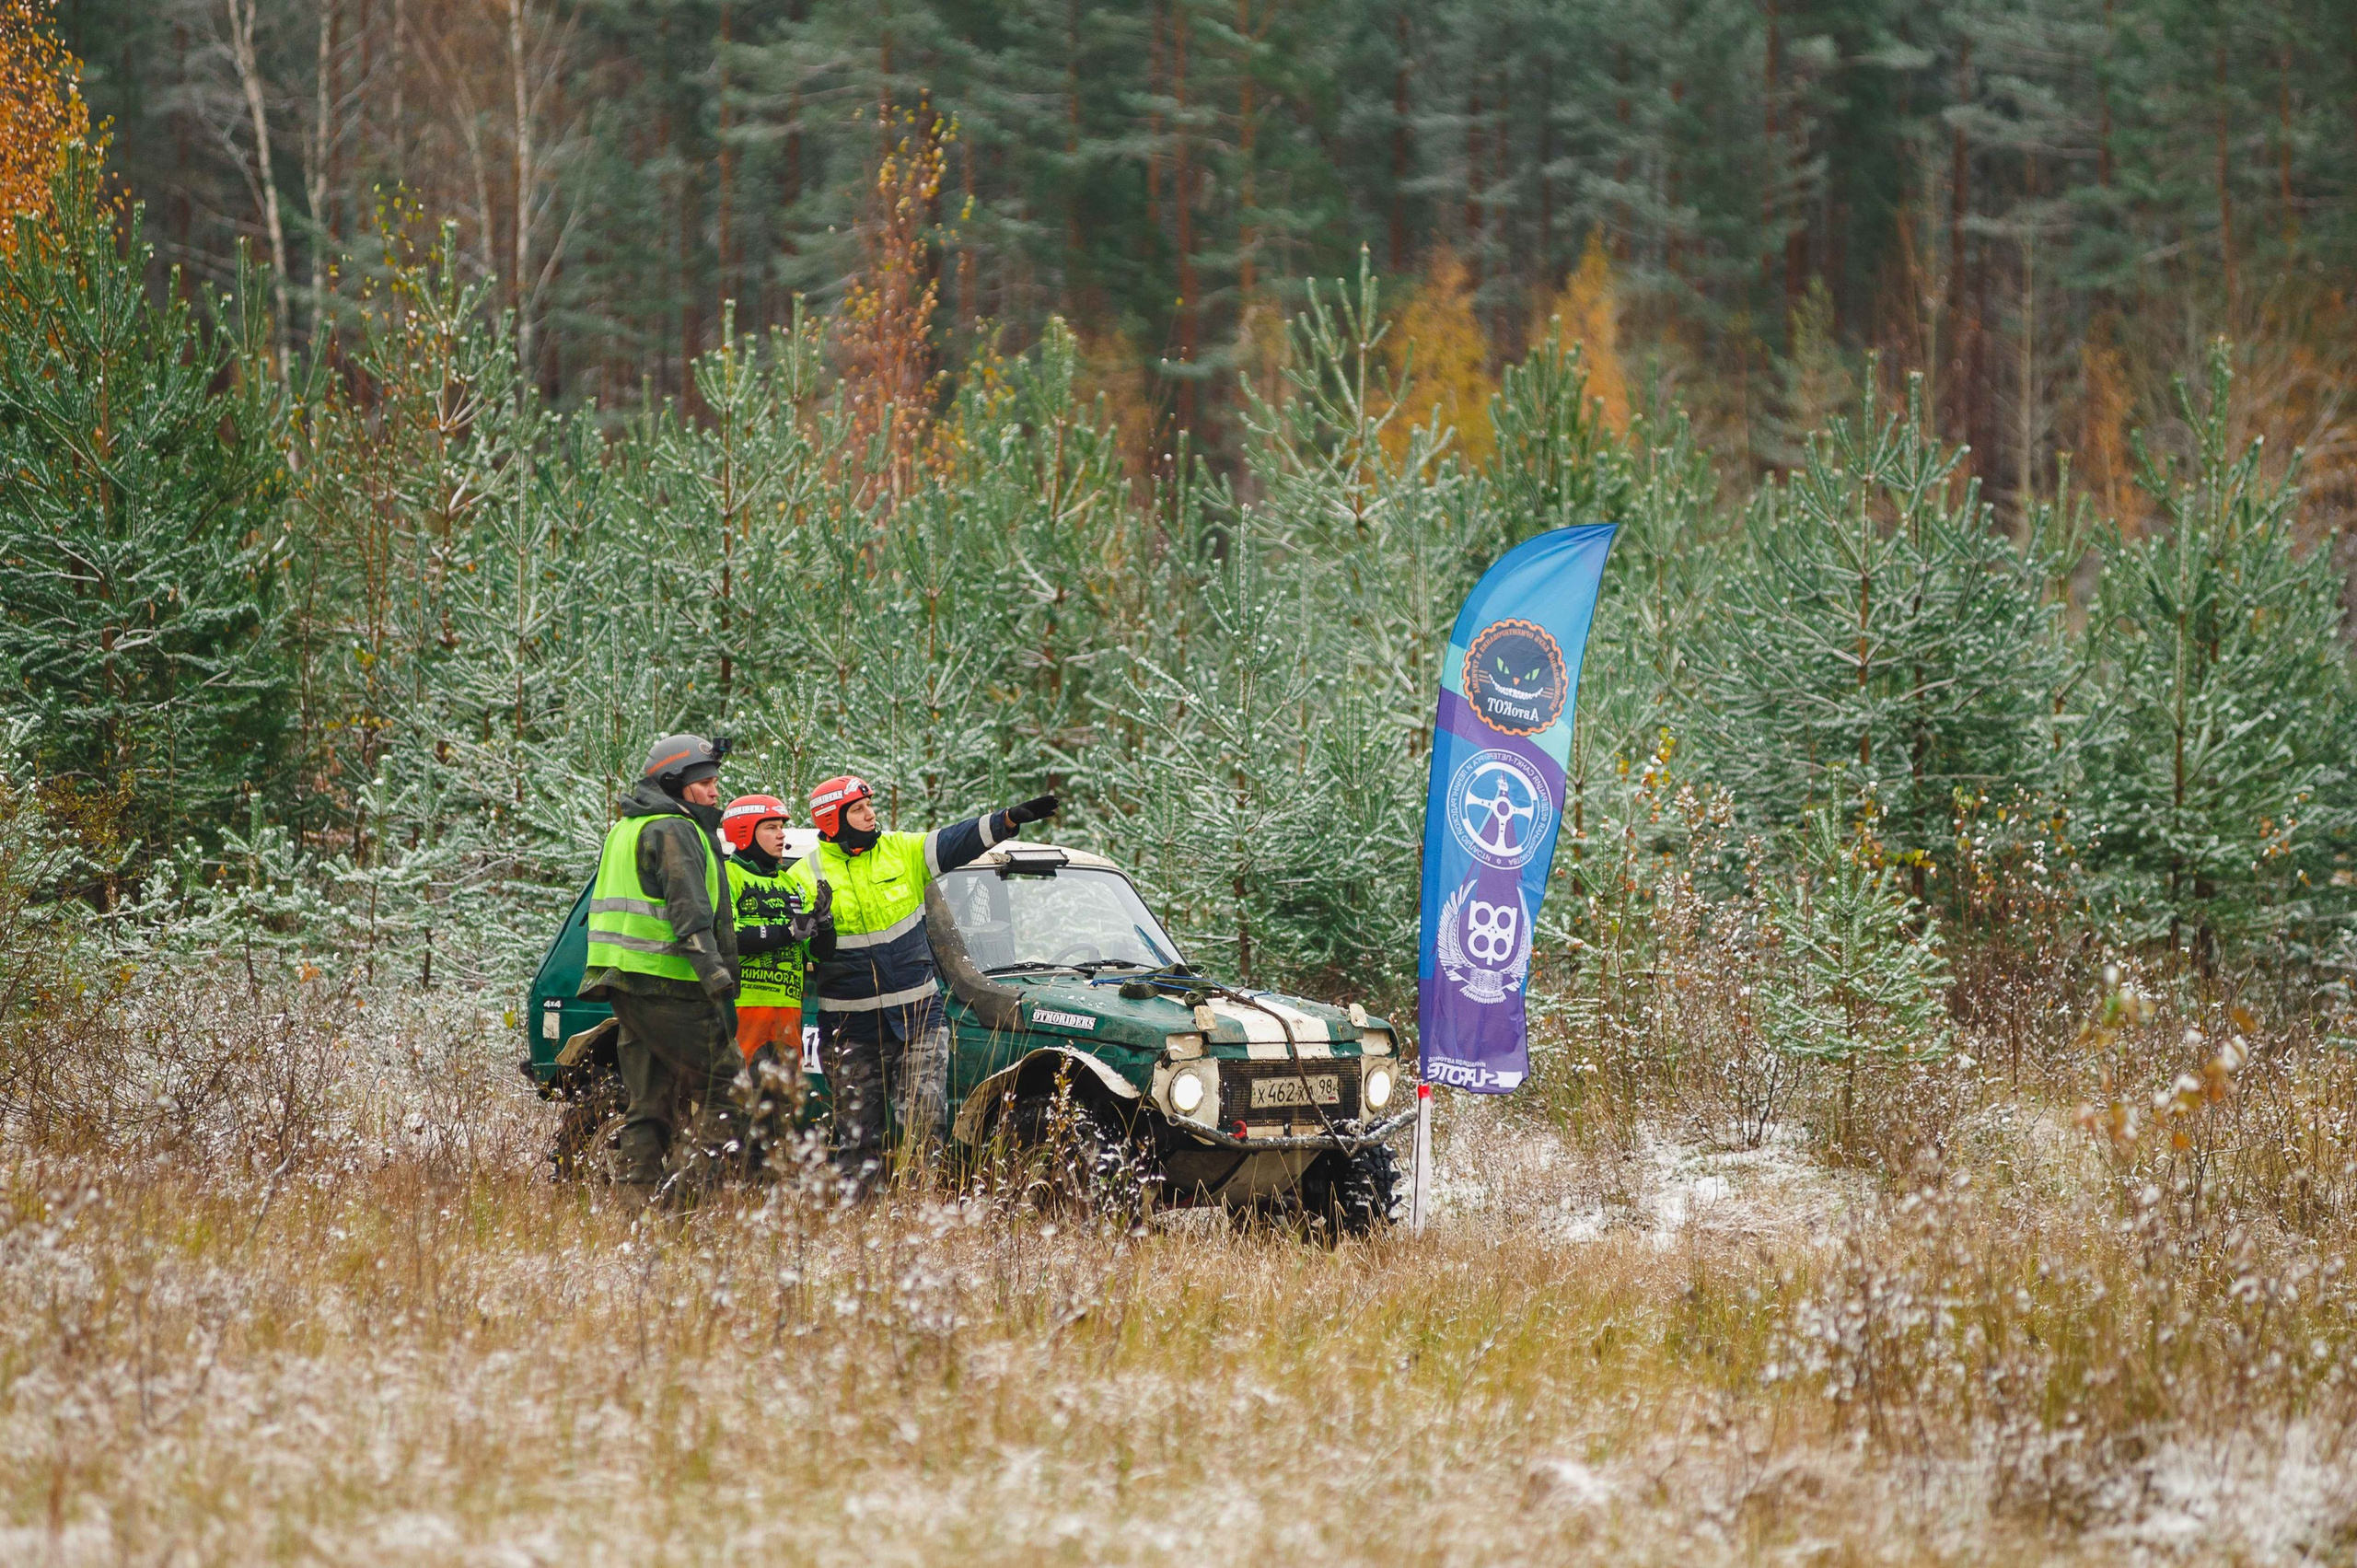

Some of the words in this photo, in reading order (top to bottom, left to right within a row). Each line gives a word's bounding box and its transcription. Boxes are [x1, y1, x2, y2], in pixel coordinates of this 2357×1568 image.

[741, 968, 795, 985] KIKIMORA
[786, 985, 801, 1000] CRE
[1032, 1010, 1096, 1028] OTMORIDERS
[1318, 1079, 1333, 1094] 98
